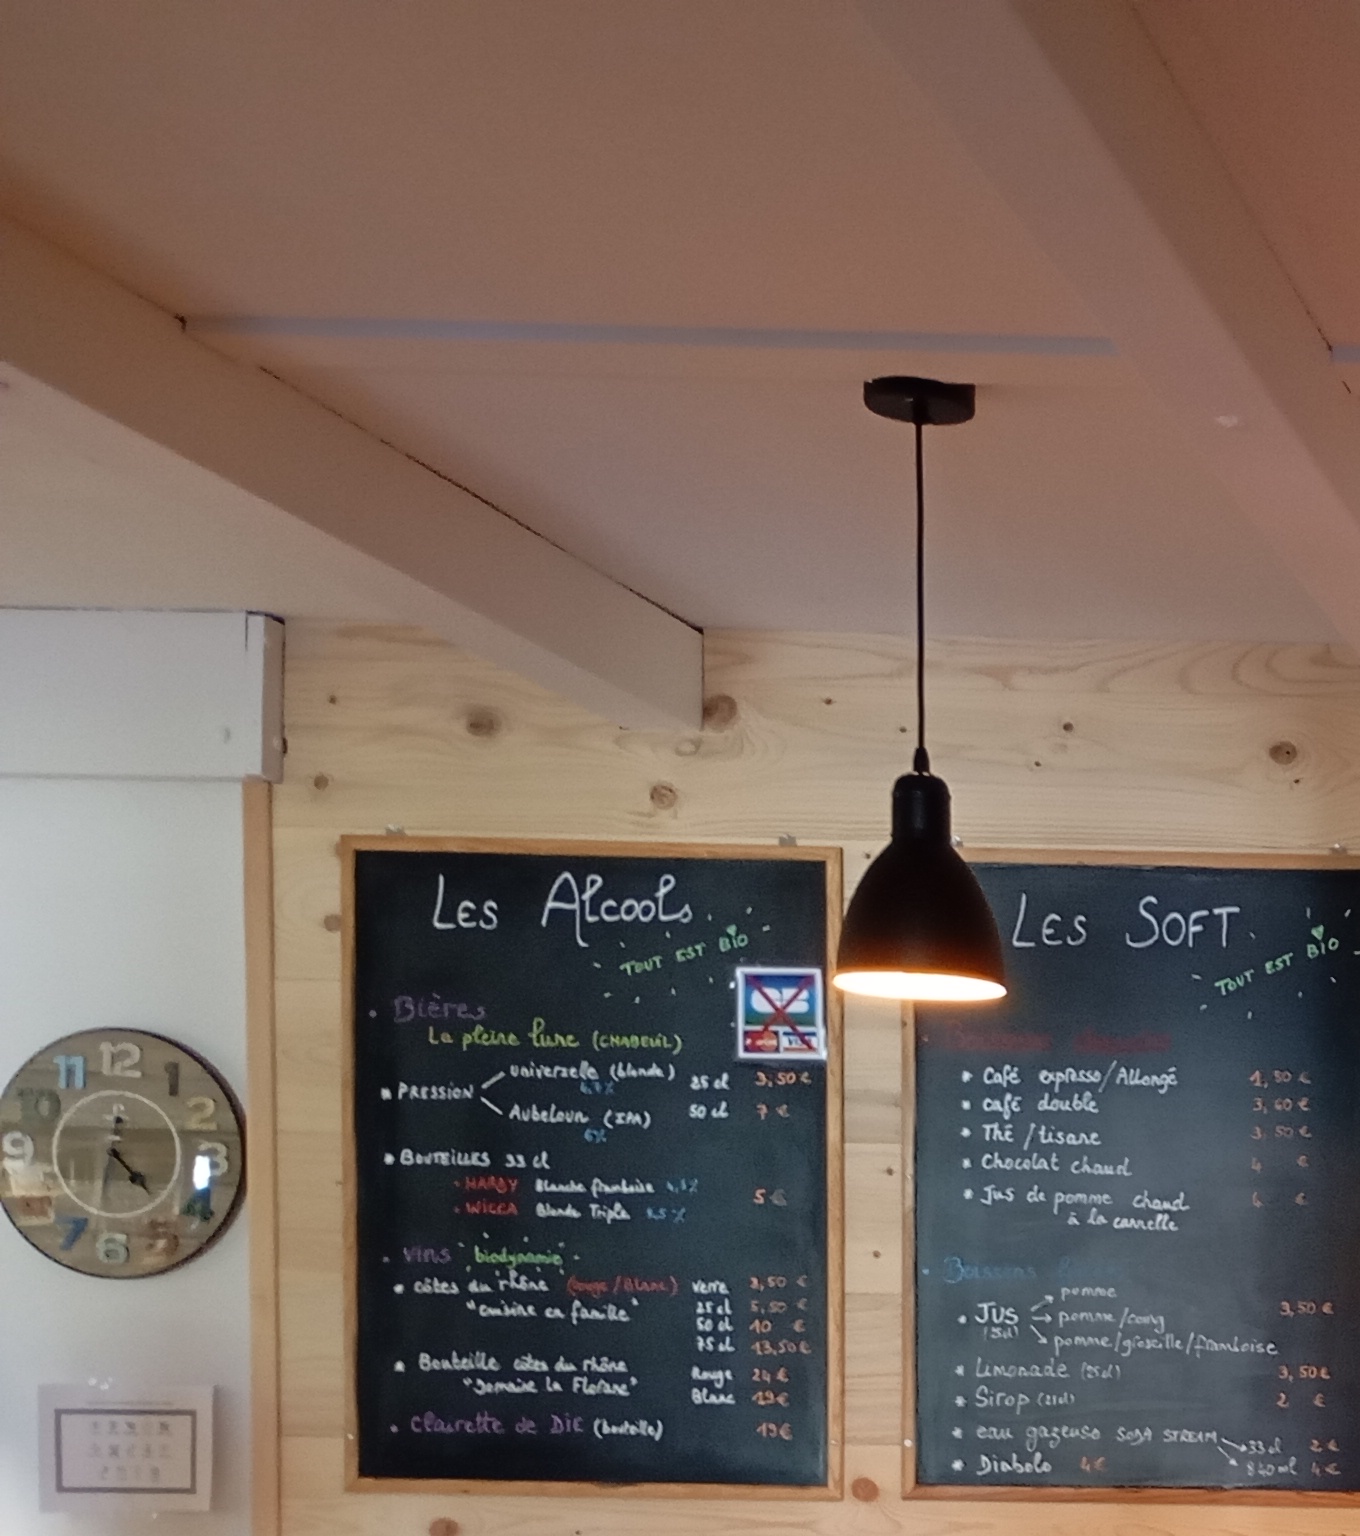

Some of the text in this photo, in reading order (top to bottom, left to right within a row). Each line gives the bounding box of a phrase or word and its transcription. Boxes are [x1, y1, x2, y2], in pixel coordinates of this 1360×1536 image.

[620, 955, 663, 978] TOUT
[675, 943, 708, 963] EST
[1215, 969, 1256, 996] TOUT
[1265, 952, 1294, 973] EST
[101, 1041, 143, 1079] 12
[186, 1096, 217, 1131] 2
[1038, 1091, 1099, 1113] double
[981, 1153, 1060, 1172] Chocolat
[1071, 1157, 1132, 1176] chaud
[1027, 1184, 1047, 1203] de
[1054, 1191, 1113, 1215] pomme
[1132, 1190, 1190, 1211] chaud
[1061, 1286, 1118, 1301] pomme
[976, 1452, 1052, 1476] Diabolo
